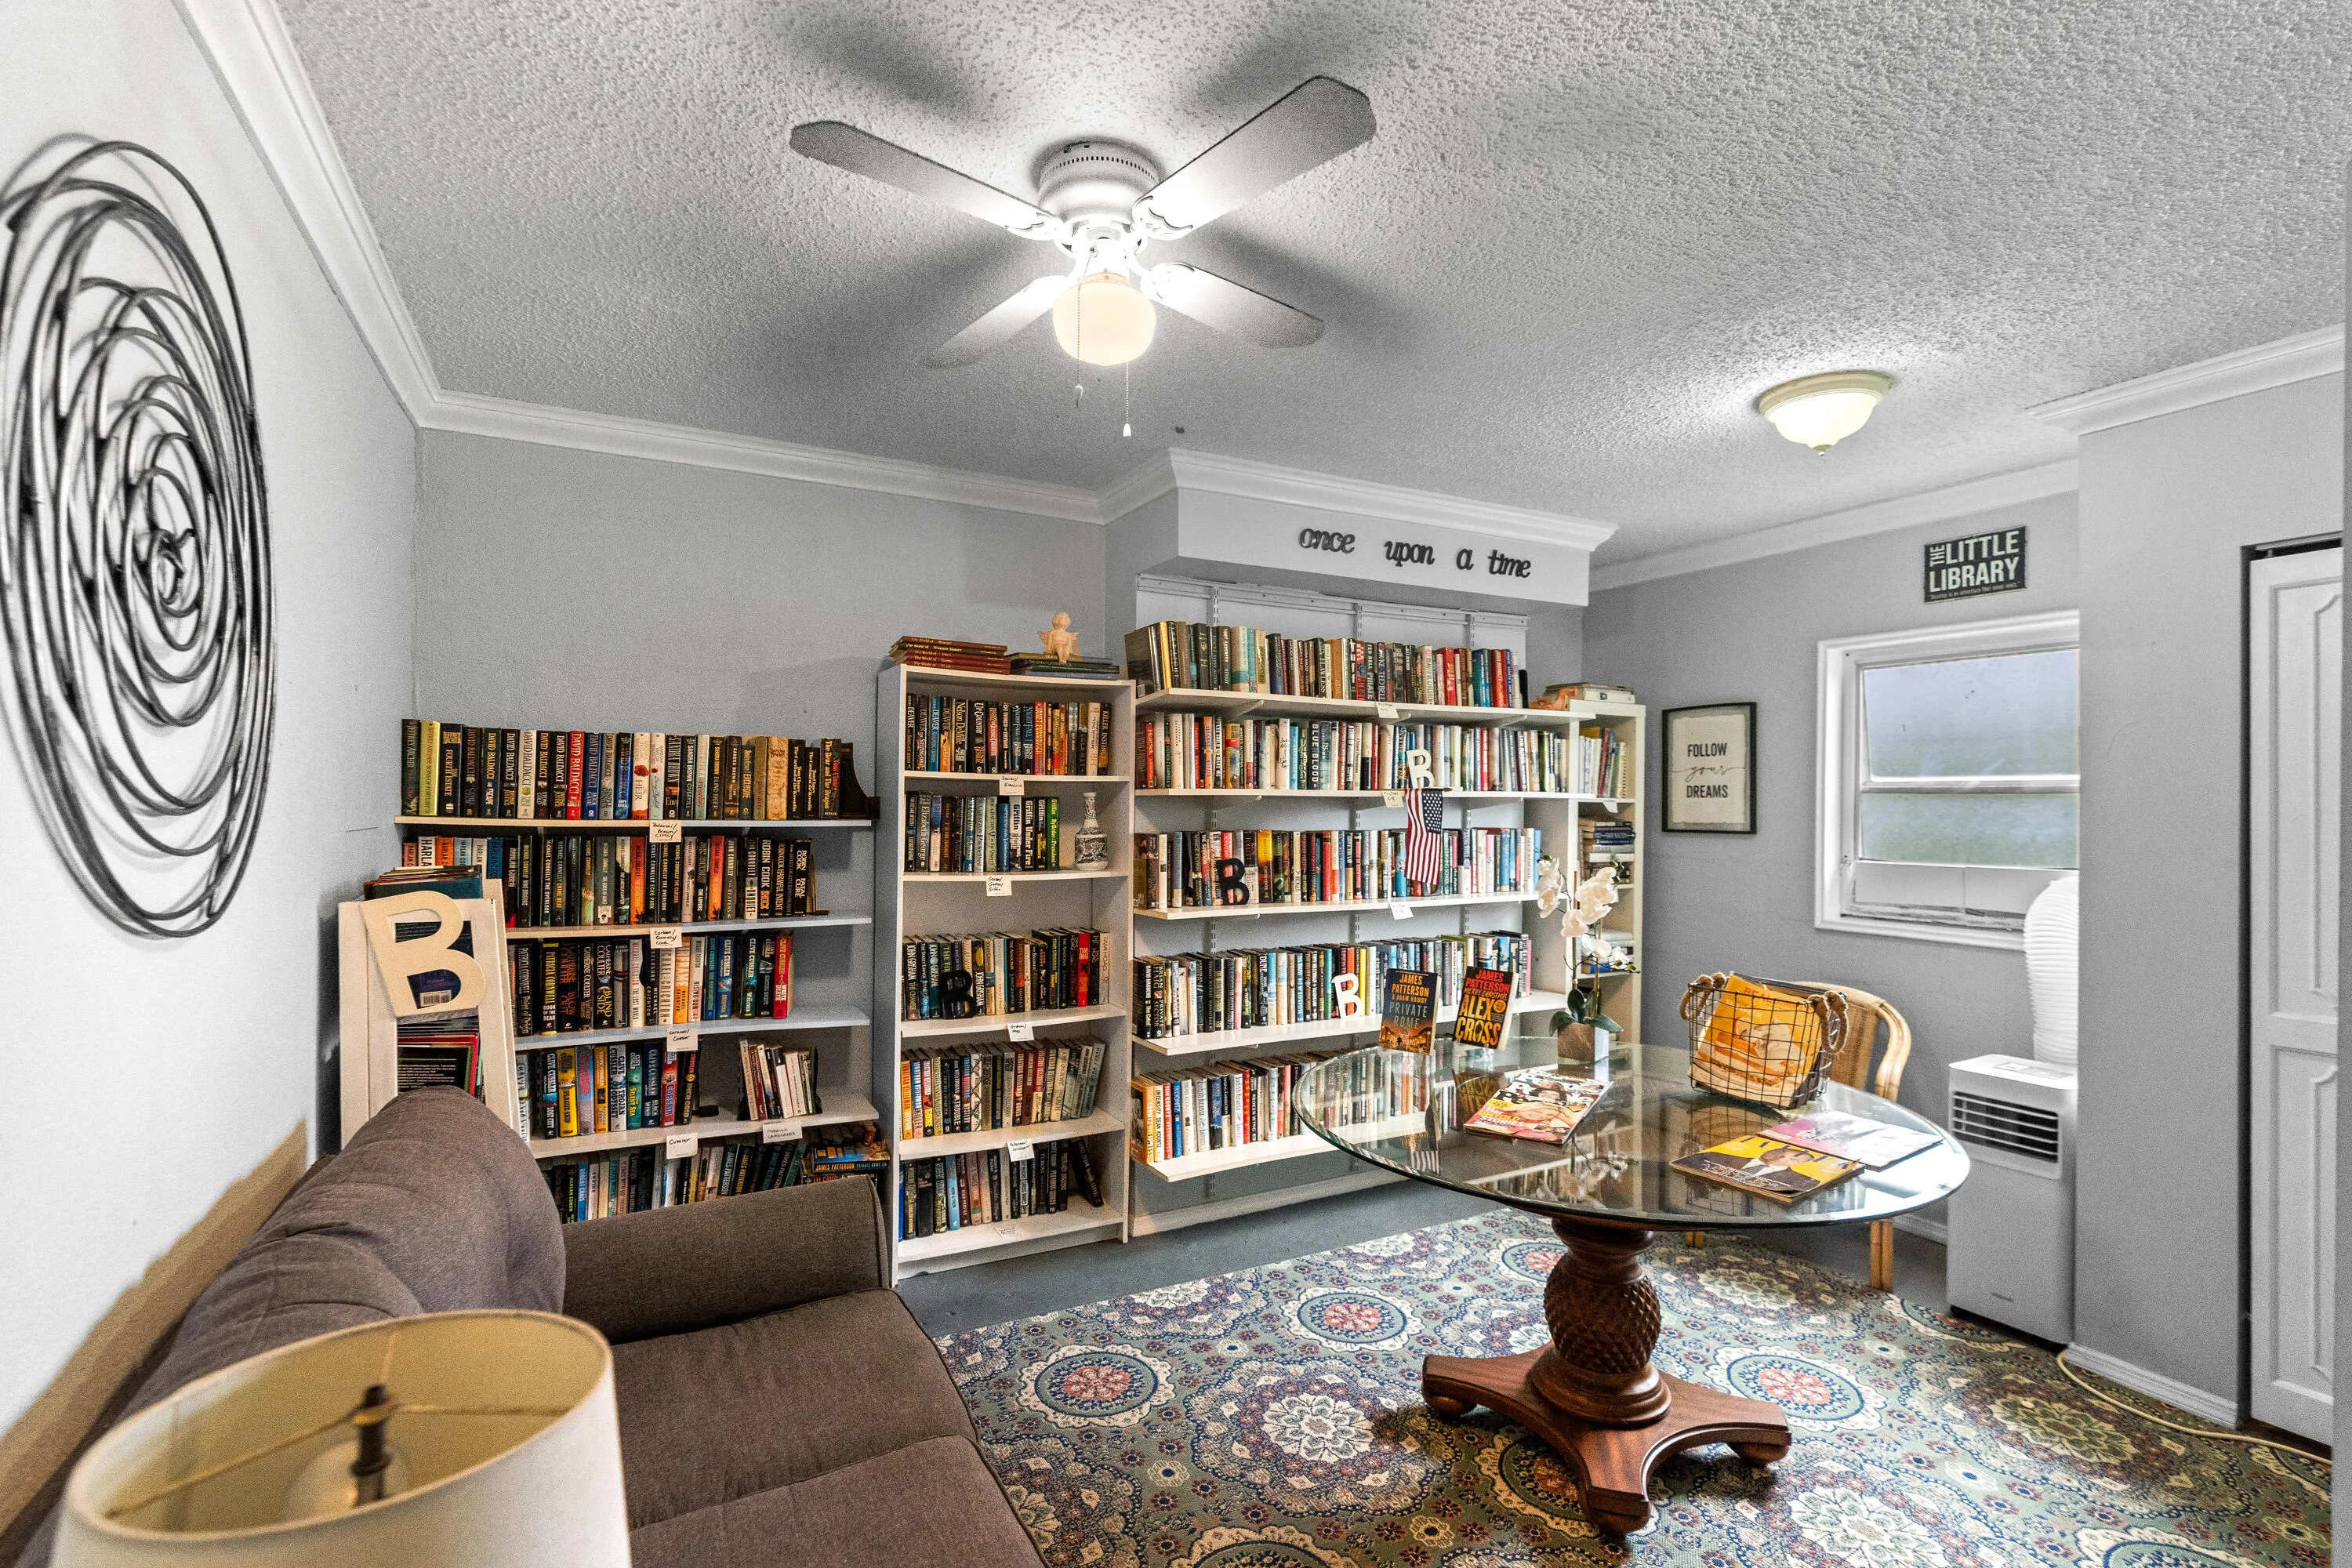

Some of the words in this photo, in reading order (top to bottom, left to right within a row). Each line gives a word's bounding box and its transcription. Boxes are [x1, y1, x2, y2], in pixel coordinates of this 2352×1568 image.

[1298, 528, 1356, 554] once
[1383, 540, 1435, 567] upon
[1456, 548, 1474, 571] a
[1488, 550, 1531, 578] time
[1929, 545, 1945, 567] THE
[1946, 531, 2020, 564] LITTLE
[1929, 557, 2020, 593] LIBRARY
[956, 702, 965, 721] Nelson
[488, 732, 496, 750] DAVID
[507, 733, 516, 751] DAVID
[540, 732, 549, 751] DAVID
[956, 722, 965, 744] DeMille
[572, 733, 582, 756] DAVID
[1687, 742, 1727, 757] FOLLOW
[487, 752, 495, 779] BALDACCI
[505, 752, 514, 780] BALDACCI
[539, 753, 549, 779] BALDACCI
[555, 754, 564, 782] BALDACCI
[568, 757, 581, 795] BALDACCI
[1406, 749, 1435, 789] B
[1687, 785, 1728, 798] DREAMS
[920, 805, 929, 837] Elizabeth
[1025, 800, 1033, 825] Griffin
[1025, 826, 1033, 848] Under
[422, 840, 432, 866] HARLA
[761, 840, 771, 863] ROBIN
[920, 837, 928, 861] George
[1025, 849, 1033, 867] Fire
[760, 866, 770, 888] COOK
[1216, 858, 1250, 905] B
[358, 891, 485, 1018] B
[907, 945, 916, 956] JOHN
[908, 957, 917, 981] GRISHAM
[931, 965, 939, 987] GRISHAM
[975, 972, 984, 984] JOHN
[1399, 974, 1423, 985] JAMES
[1475, 970, 1504, 982] JAMES
[975, 985, 985, 1006] GRISHAM
[1332, 973, 1363, 1019] B
[1392, 984, 1429, 998] PATTERSON
[1464, 988, 1483, 997] MERRY
[1465, 978, 1511, 993] PATTERSON
[1389, 1002, 1428, 1018] PRIVATE
[1459, 994, 1495, 1022] ALEX
[1393, 1015, 1419, 1029] ROME
[1455, 1016, 1501, 1046] CROSS
[546, 1053, 556, 1069] CLIVE
[546, 1069, 557, 1093] CUSSLER
[665, 1083, 676, 1116] CORSAIR
[1479, 1111, 1520, 1121] UNTOLD
[1479, 1116, 1524, 1127] STORIES
[721, 1168, 733, 1196] PATTERSON
